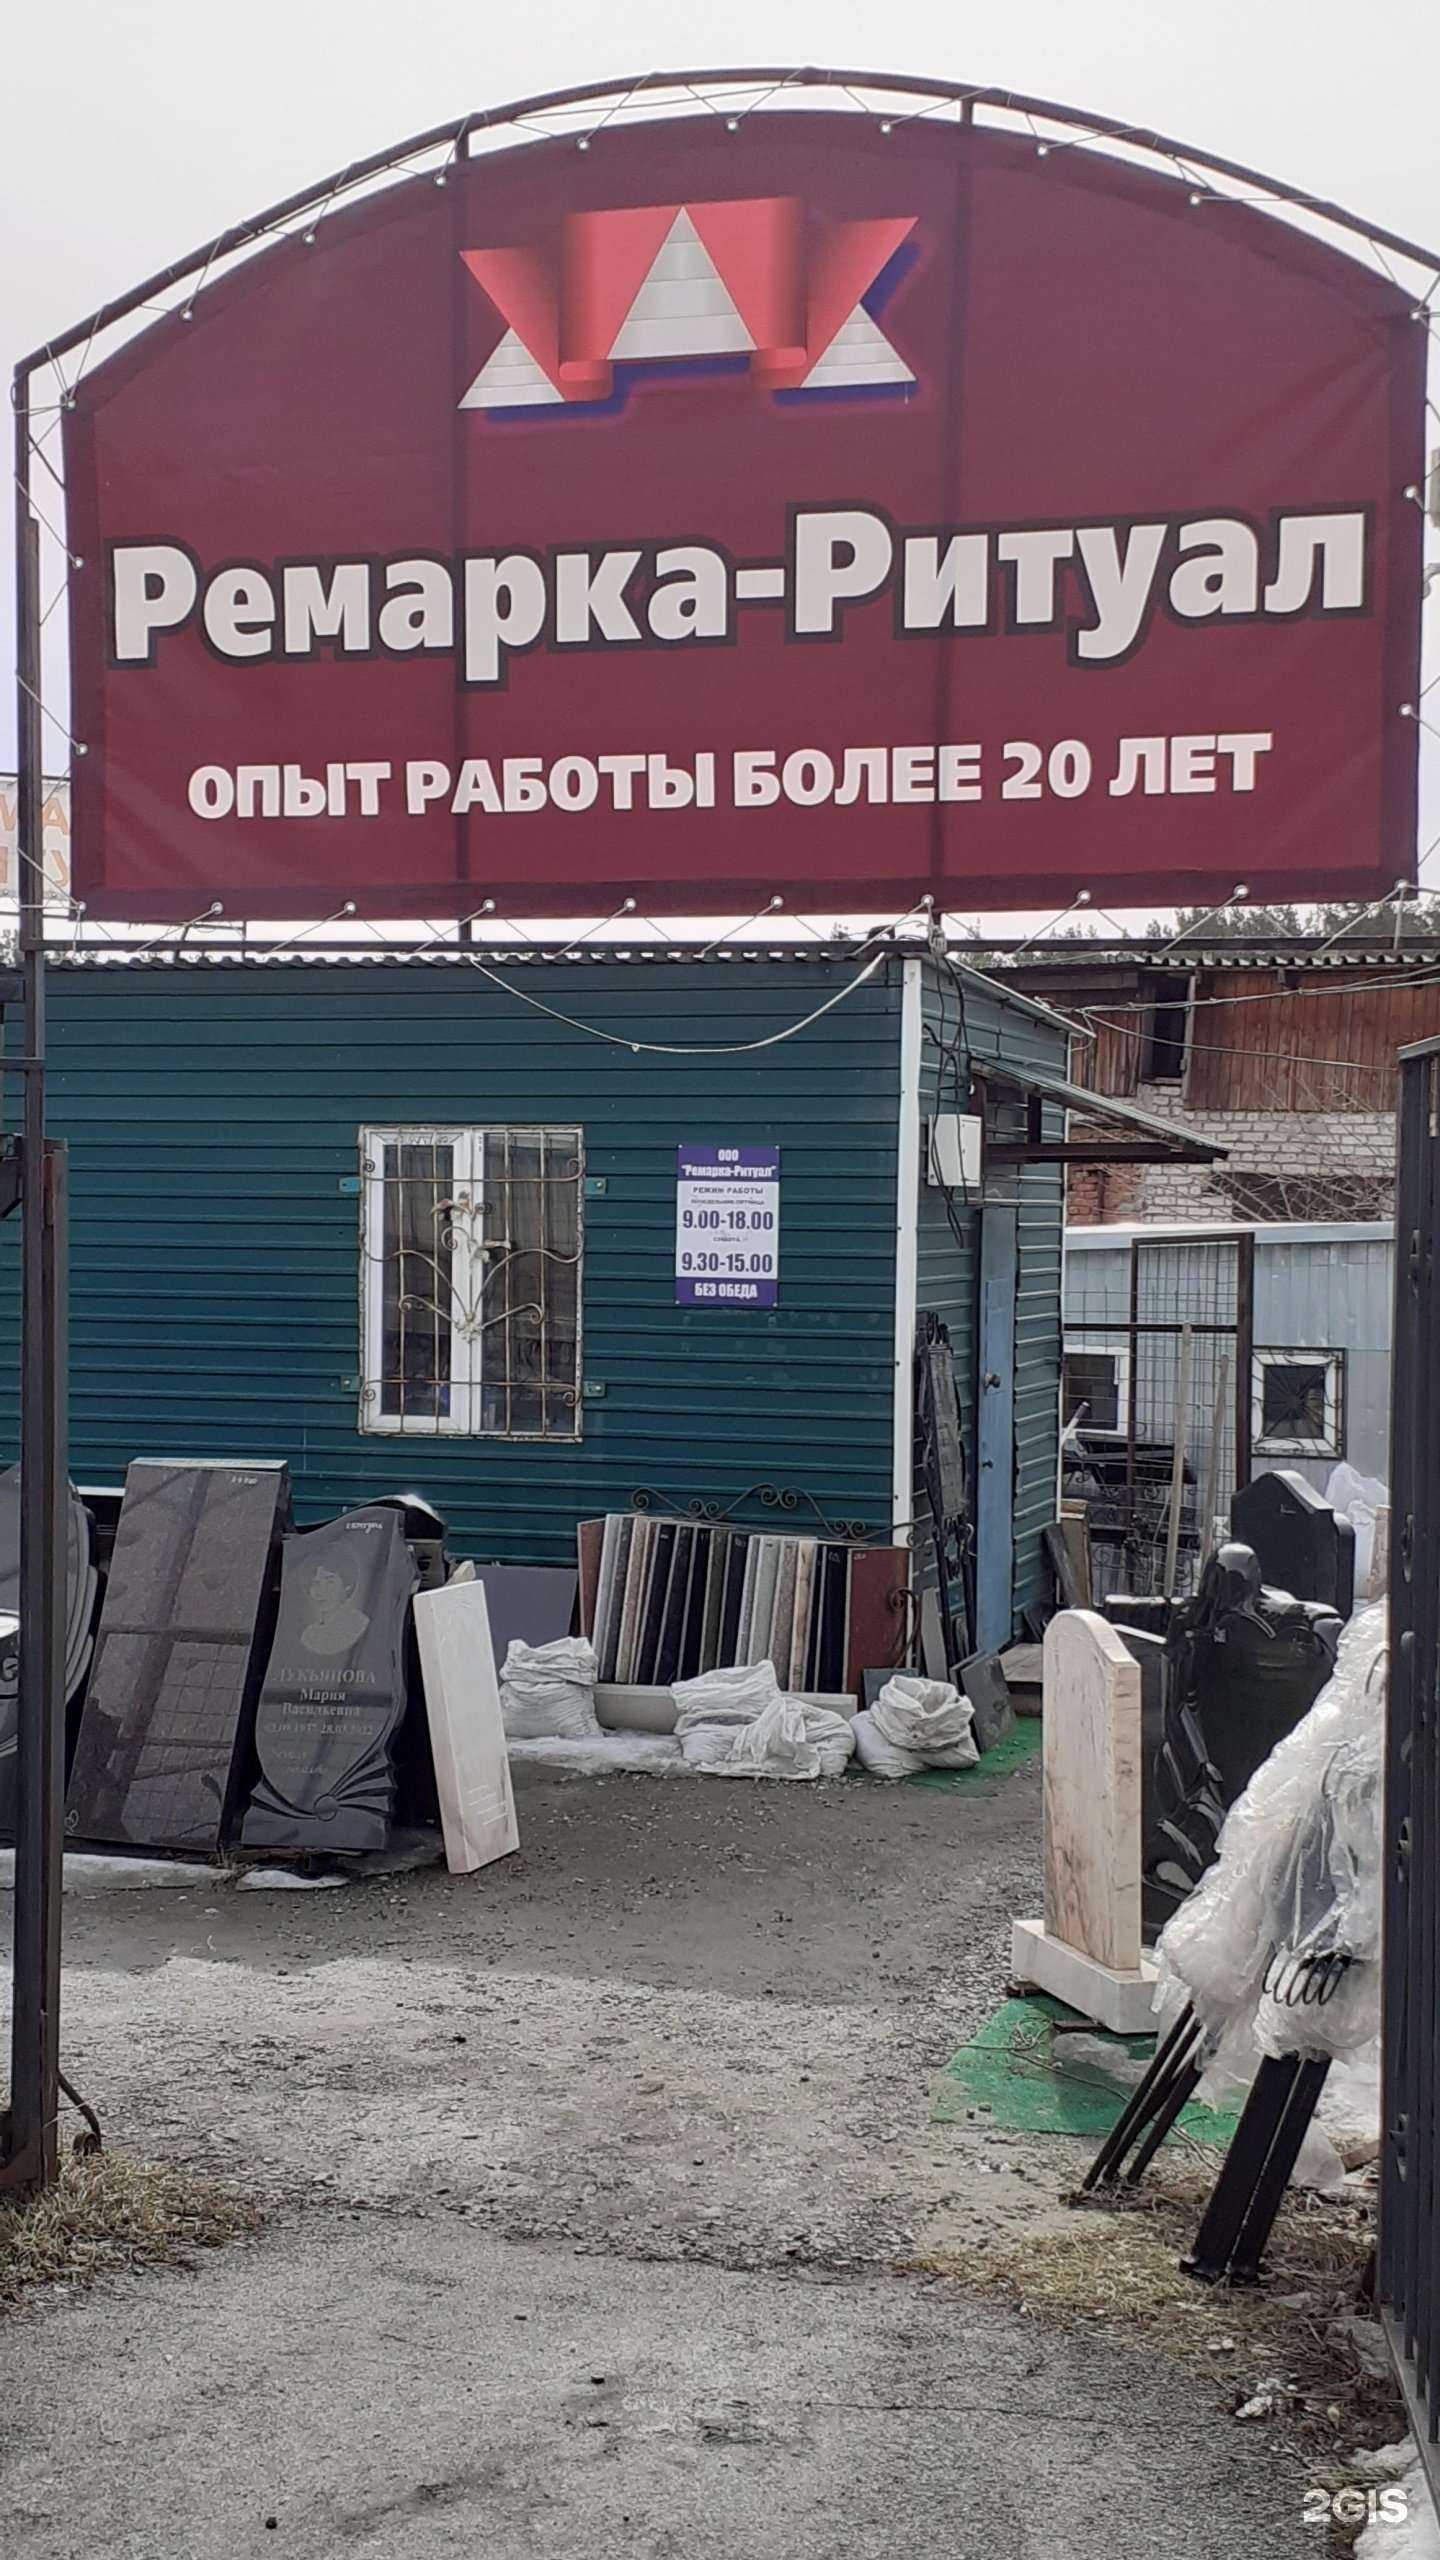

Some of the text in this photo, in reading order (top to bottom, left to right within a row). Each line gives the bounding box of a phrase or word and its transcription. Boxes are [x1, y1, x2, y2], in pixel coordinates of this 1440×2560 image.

[113, 510, 1365, 681] Ремарка-Ритуал
[187, 732, 1273, 819] ОПЫТ РАБОТЫ БОЛЕЕ 20 ЛЕТ
[683, 1210, 774, 1230] 9.00-18.00
[682, 1253, 773, 1273] 9.30-15.00
[694, 1283, 758, 1300] БЕЗ ОБЕДА
